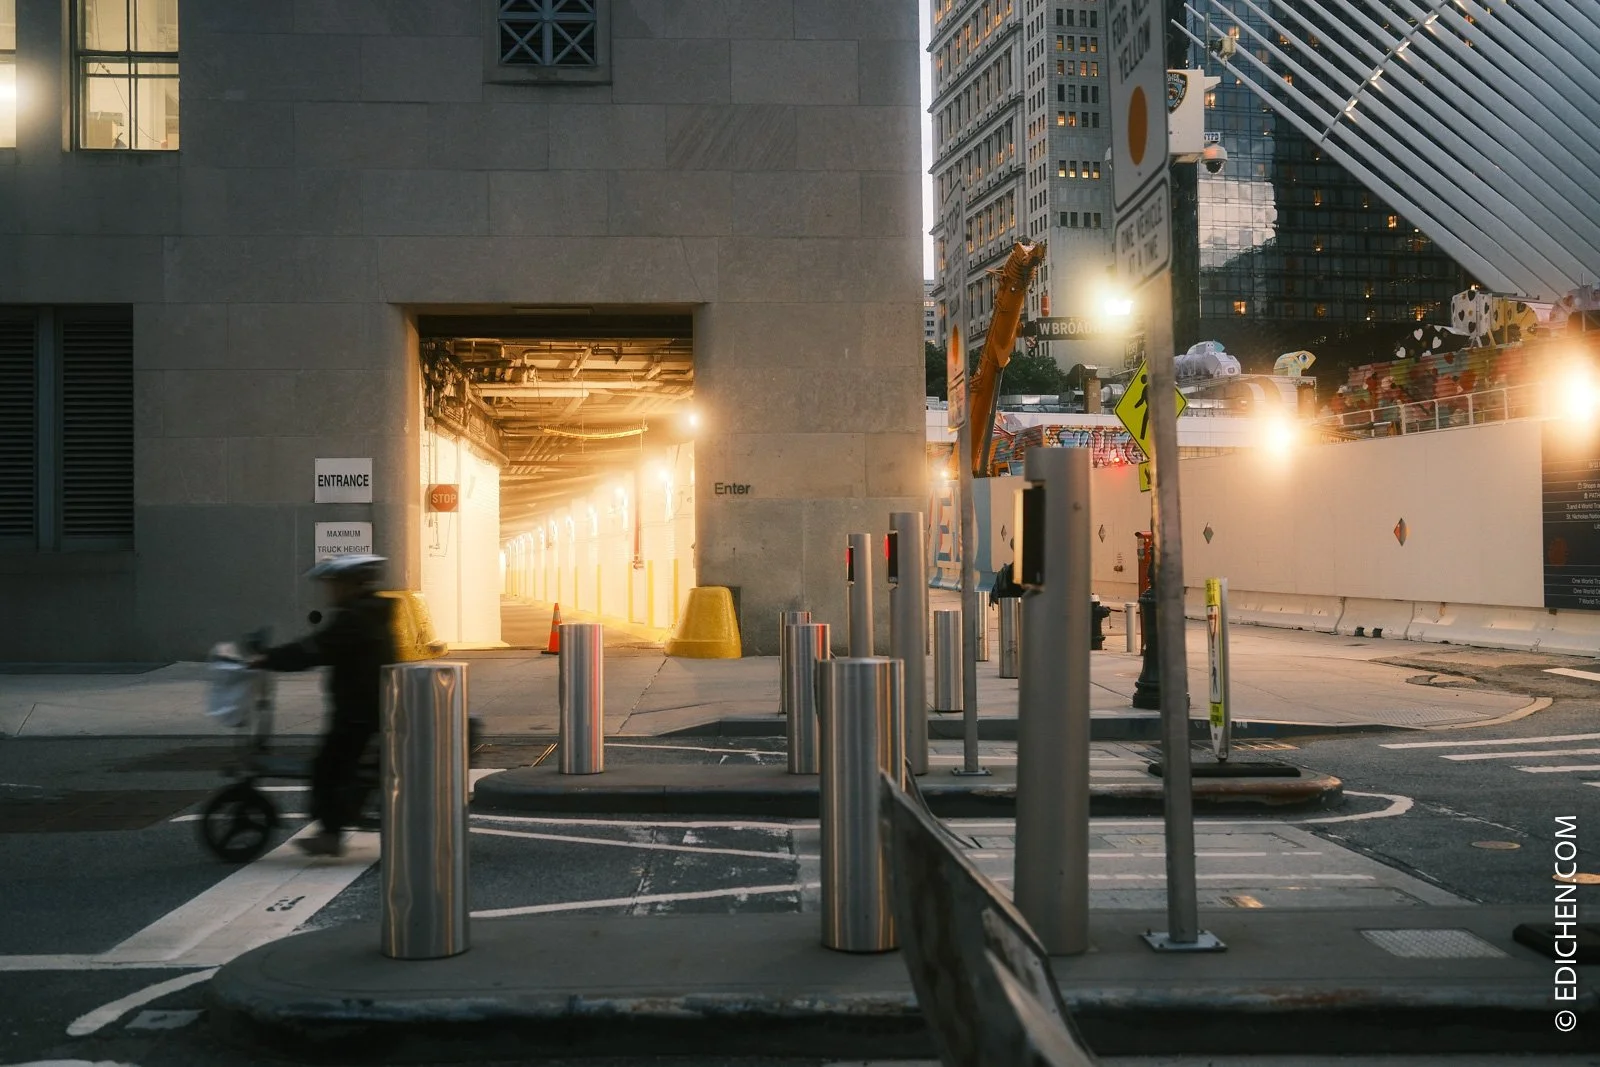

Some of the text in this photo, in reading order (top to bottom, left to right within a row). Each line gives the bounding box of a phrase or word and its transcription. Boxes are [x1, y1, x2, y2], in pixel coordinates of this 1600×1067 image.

[1118, 15, 1151, 85] YELLOW
[1040, 321, 1105, 335] W BROAD
[317, 474, 369, 487] ENTRANCE
[714, 482, 751, 495] Enter
[432, 493, 457, 504] STOP
[317, 545, 370, 553] TRUCK HEIGHT
